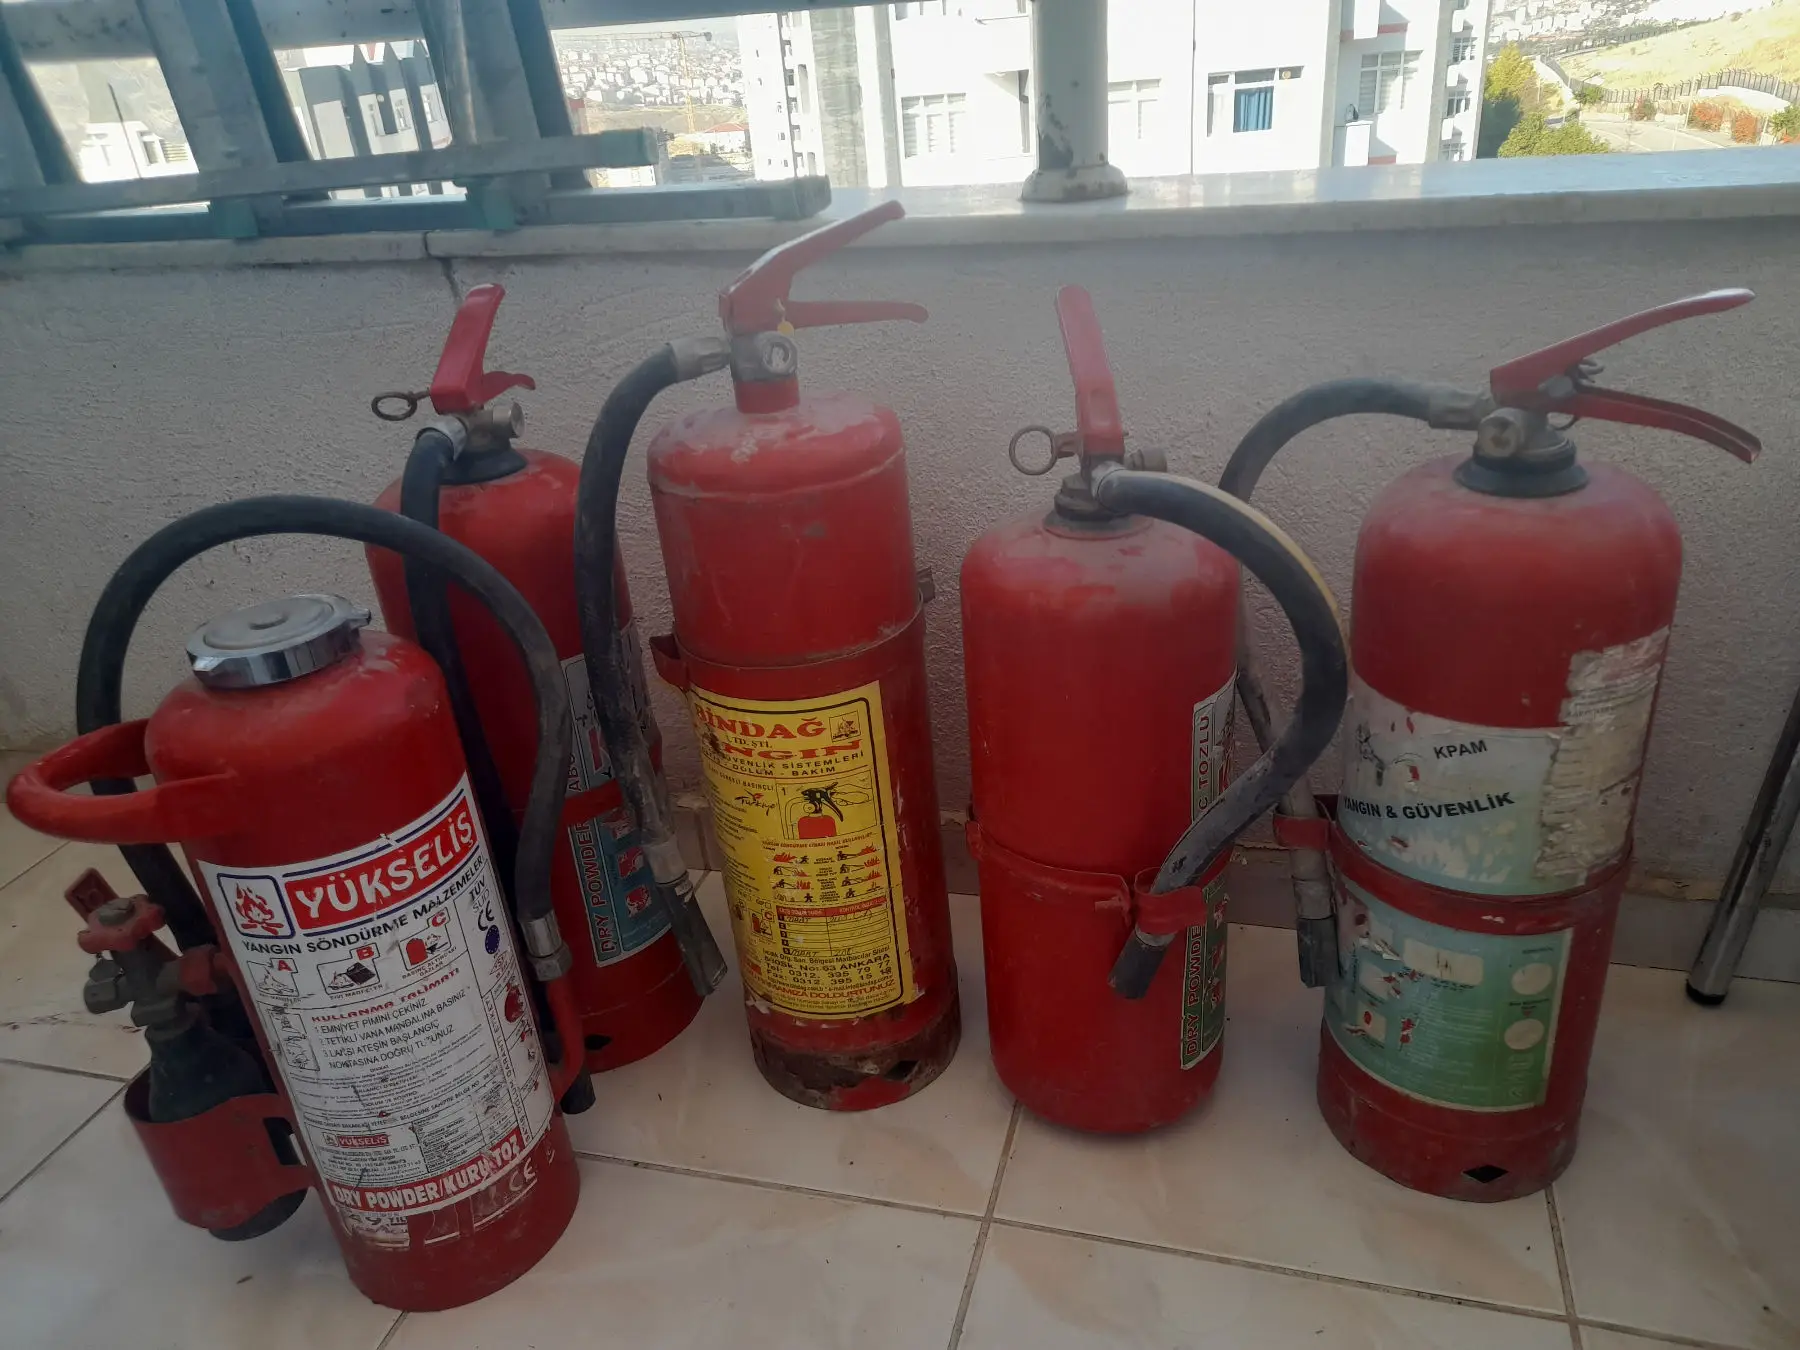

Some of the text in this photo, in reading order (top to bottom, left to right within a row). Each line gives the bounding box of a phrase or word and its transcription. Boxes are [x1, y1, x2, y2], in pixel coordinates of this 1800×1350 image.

[720, 738, 863, 760] NGIN
[782, 751, 864, 769] SİSTEMLERİ
[1198, 714, 1210, 788] TOZLU
[1433, 739, 1488, 759] KPAM
[732, 762, 774, 776] DOLUM
[792, 766, 836, 776] BAKIM
[1344, 791, 1515, 819] YANGIN & GÜVENLİK
[296, 811, 475, 919] YÜKSELİŞ
[431, 910, 448, 927] C
[243, 940, 302, 955] YANGIN
[307, 914, 409, 953] SÖNDÜRME
[595, 914, 617, 953] DRY
[355, 946, 375, 960] B
[840, 953, 890, 970] ANKARA
[277, 960, 292, 972] A
[1185, 925, 1203, 1057] DRY POWDE
[312, 1001, 394, 1022] KULLANMA
[321, 1020, 359, 1035] EMNİYET
[392, 998, 428, 1022] ÇEKİNİZ
[359, 1026, 385, 1042] VANA
[384, 1009, 436, 1034] MANDALINA
[436, 989, 467, 1014] BASINIZ
[356, 1039, 389, 1057] ATEŞİN
[389, 1018, 440, 1047] BAŞLANGIÇ
[333, 1185, 362, 1208] DRY
